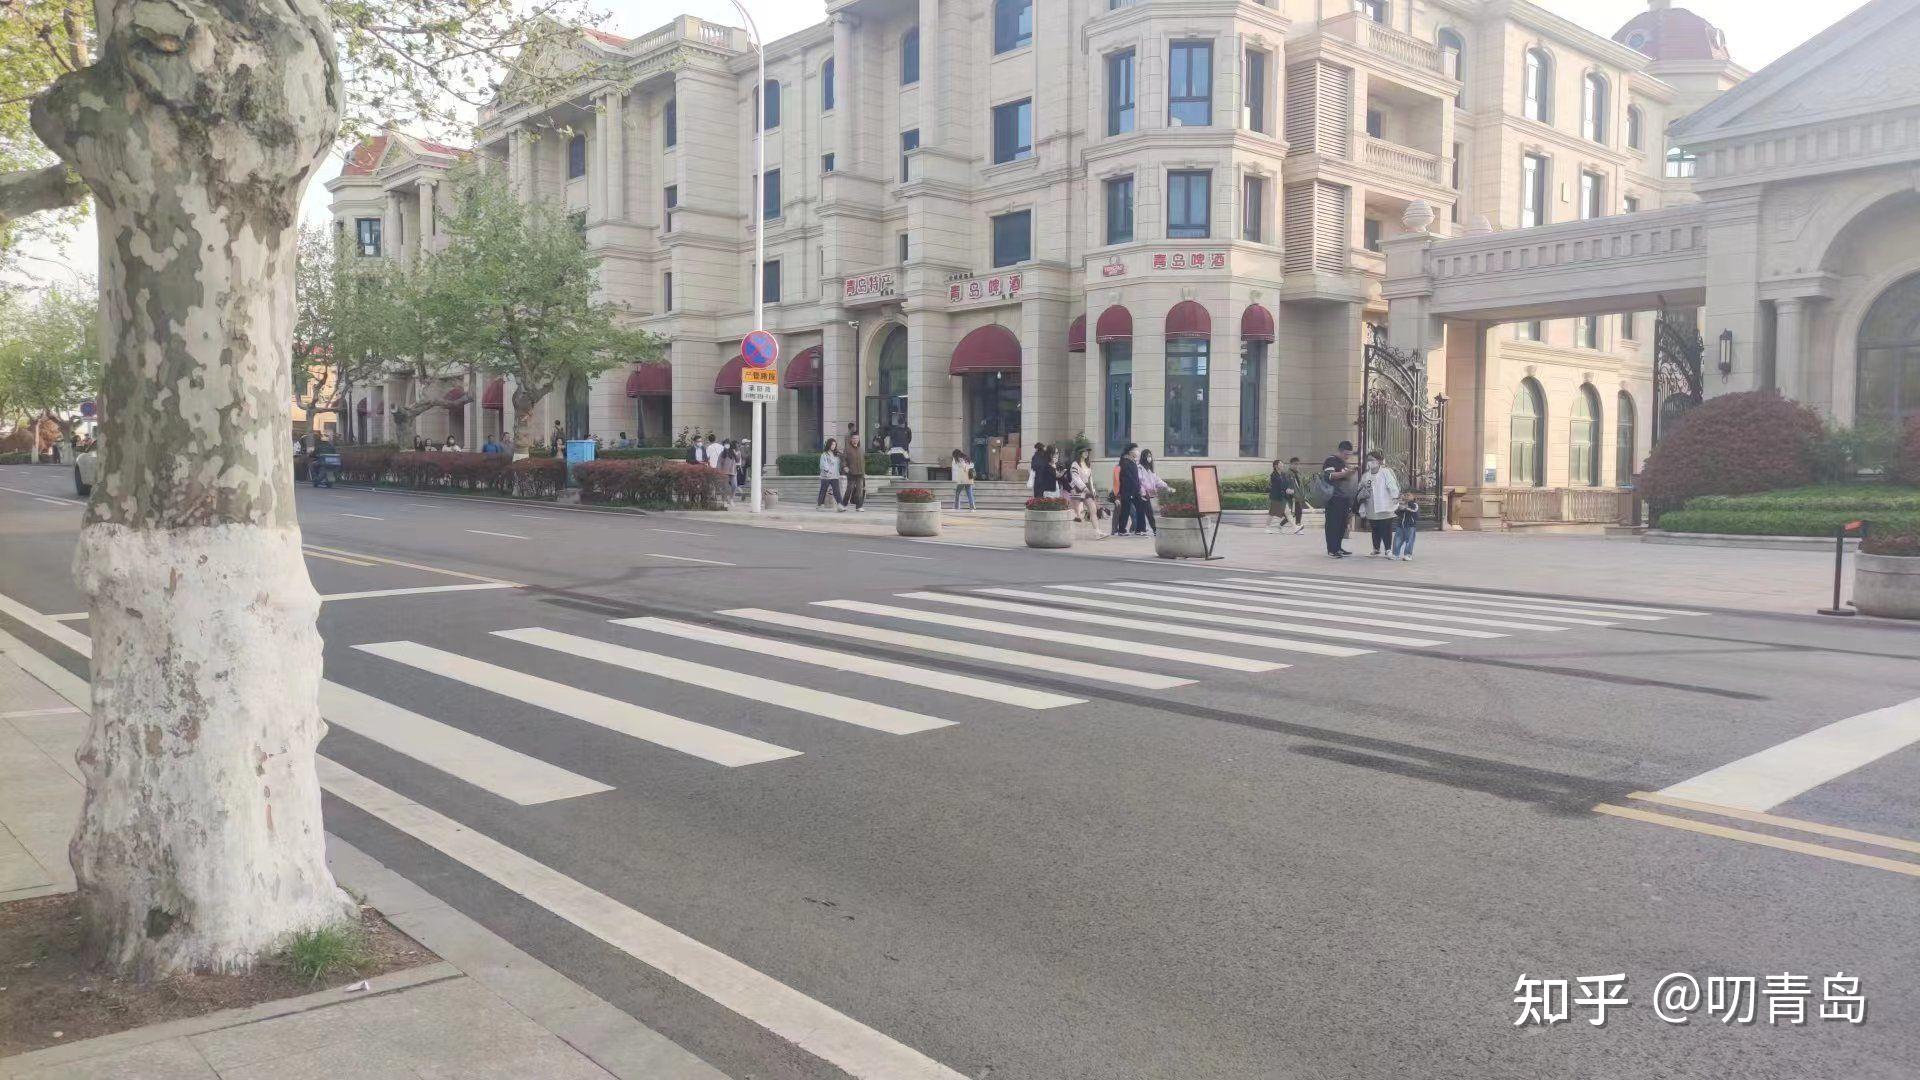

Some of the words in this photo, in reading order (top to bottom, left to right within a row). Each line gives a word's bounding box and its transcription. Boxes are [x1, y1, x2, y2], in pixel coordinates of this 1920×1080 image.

[1153, 253, 1225, 269] 青岛啤酒
[950, 273, 1022, 303] 青岛啤酒
